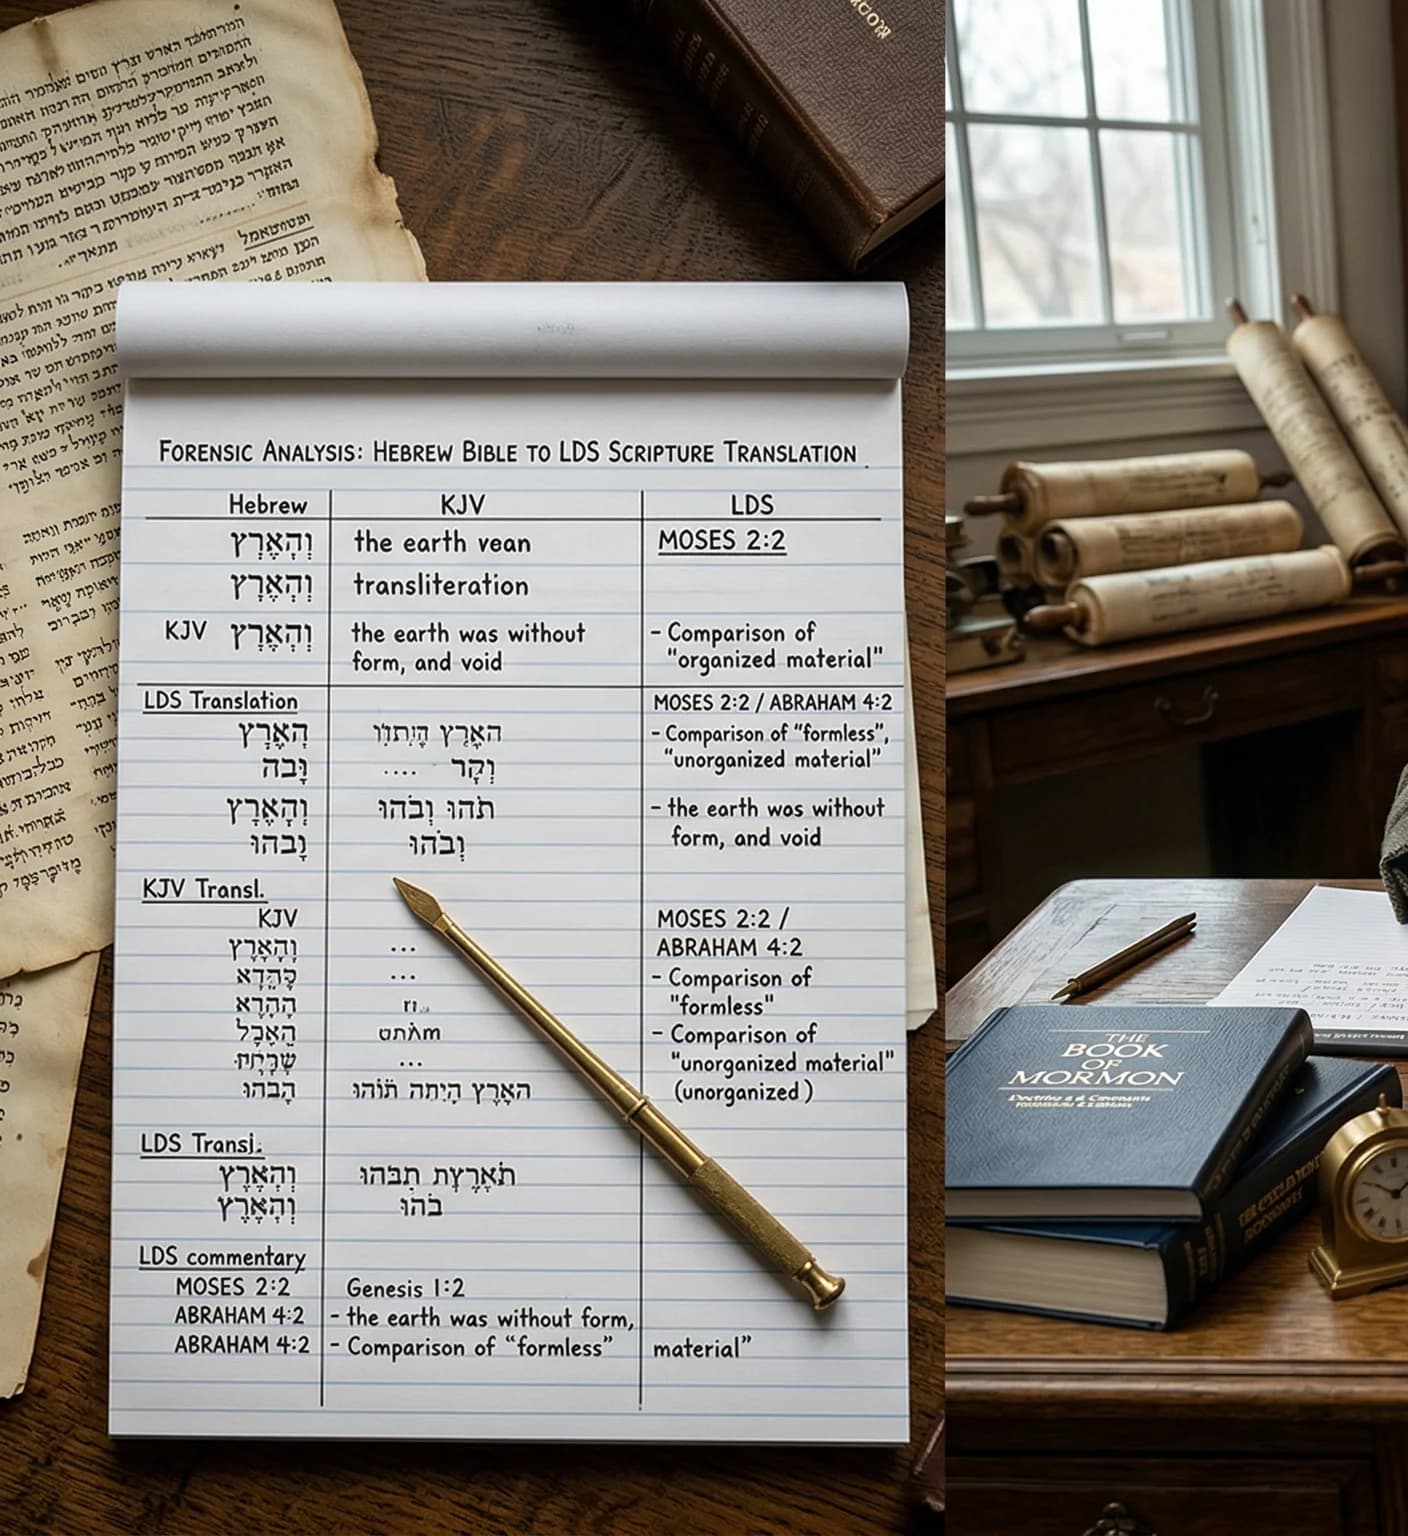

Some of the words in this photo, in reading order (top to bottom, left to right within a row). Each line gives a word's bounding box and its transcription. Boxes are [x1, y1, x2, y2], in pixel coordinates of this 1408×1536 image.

[160, 440, 253, 462] FORENSIC
[263, 440, 362, 462] ANALYSIS:
[374, 440, 453, 462] HEBREW
[463, 440, 517, 462] BIBLE
[526, 445, 551, 462] TO
[560, 440, 599, 462] LDS
[609, 440, 714, 463] SCRIPTURE
[723, 440, 856, 463] TRANSLATION
[230, 493, 307, 514] Hebrew
[442, 494, 485, 515] KJV
[732, 494, 774, 515] LDS
[354, 529, 392, 552] the
[403, 529, 466, 552] earth
[478, 538, 531, 552] vean
[659, 529, 736, 550] MOSES
[747, 530, 785, 550] 2:2
[353, 572, 528, 596] transliteration
[166, 620, 207, 640] KJV
[351, 621, 385, 643] the
[394, 622, 449, 643] earth
[459, 629, 498, 643] was
[508, 622, 586, 643] without
[668, 621, 785, 648] Comparison
[795, 620, 816, 642] of
[352, 650, 405, 675] form,
[415, 651, 451, 671] and
[461, 650, 502, 671] void
[145, 690, 181, 709] LDS
[189, 690, 297, 709] Translation
[654, 694, 713, 711] MOSES
[720, 694, 749, 711] 2:2
[769, 694, 856, 711] ABRAHAM
[863, 693, 892, 710] 4:2
[666, 724, 764, 749] Comparison
[771, 723, 788, 742] of
[667, 797, 699, 817] the
[707, 797, 758, 817] earth
[812, 797, 885, 817] without
[672, 825, 724, 850] form,
[735, 826, 770, 847] and
[780, 826, 821, 847] void
[144, 878, 185, 898] KJV
[195, 878, 264, 899] Transl.
[259, 908, 298, 928] KJV
[658, 909, 726, 928] MOSES
[737, 909, 770, 928] 2:2
[657, 938, 757, 957] ABRAHAM
[767, 938, 803, 957] 4:2
[669, 967, 782, 993] Comparison
[791, 965, 812, 987] of
[671, 1024, 786, 1050] Comparison
[796, 1022, 817, 1044] of
[1105, 1033, 1149, 1043] THE
[1061, 1044, 1168, 1057] BOOK
[1081, 1059, 1123, 1070] OF
[1008, 1071, 1185, 1085] MORMON
[142, 1133, 181, 1153] LDS
[140, 1245, 177, 1265] LDS
[187, 1245, 306, 1274] commentary
[177, 1277, 244, 1296] MOSES
[256, 1277, 290, 1296] 2:2
[347, 1277, 422, 1298] Genesis
[435, 1278, 465, 1298] 1:2
[175, 1306, 265, 1324] ABRAHAM
[272, 1306, 304, 1325] 4:2
[346, 1306, 379, 1327] the
[388, 1306, 440, 1327] earth
[450, 1314, 487, 1327] was
[497, 1307, 572, 1328] without
[581, 1306, 636, 1331] form,
[174, 1335, 268, 1354] ABRAHAM
[276, 1336, 309, 1355] 4:2
[348, 1336, 464, 1362] Comparison
[475, 1335, 496, 1356] of
